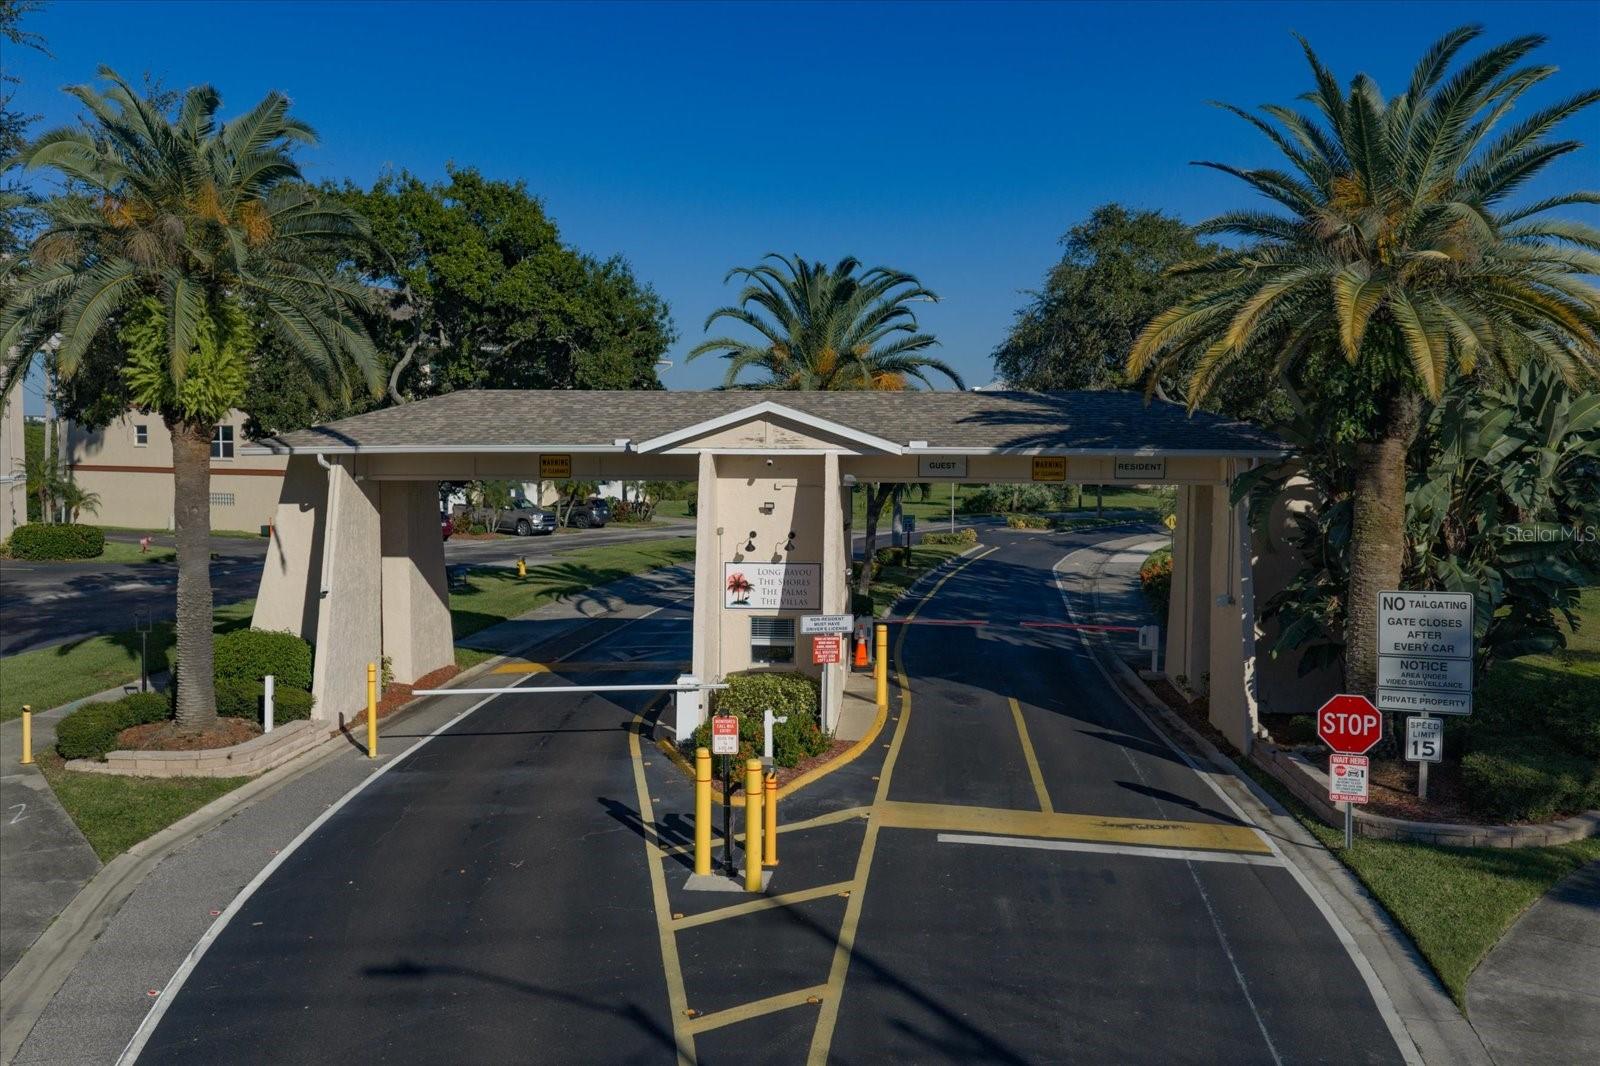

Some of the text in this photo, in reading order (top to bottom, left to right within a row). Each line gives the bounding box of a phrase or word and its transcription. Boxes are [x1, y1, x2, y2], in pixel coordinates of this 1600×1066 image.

[1118, 463, 1162, 471] RESIDENT
[757, 568, 812, 576] LONG BAYOU
[759, 577, 810, 586] THE SHORES
[762, 588, 808, 596] THE PALMS
[781, 598, 808, 606] VILLAS
[1383, 596, 1467, 611] NO TAILGATING
[1387, 617, 1463, 628] GATE CLOSES
[1407, 631, 1442, 640] AFTER
[1394, 642, 1455, 653] EVERY CAR
[1400, 660, 1448, 672] NOTICE
[1408, 679, 1463, 689] SURVEILLANCE
[1381, 695, 1466, 707] PRIVATE PROPERTY
[1322, 712, 1377, 736] STOP
[1410, 721, 1440, 730] SPEED
[1412, 740, 1436, 757] 15
[1333, 756, 1367, 766] WAIT HERE
